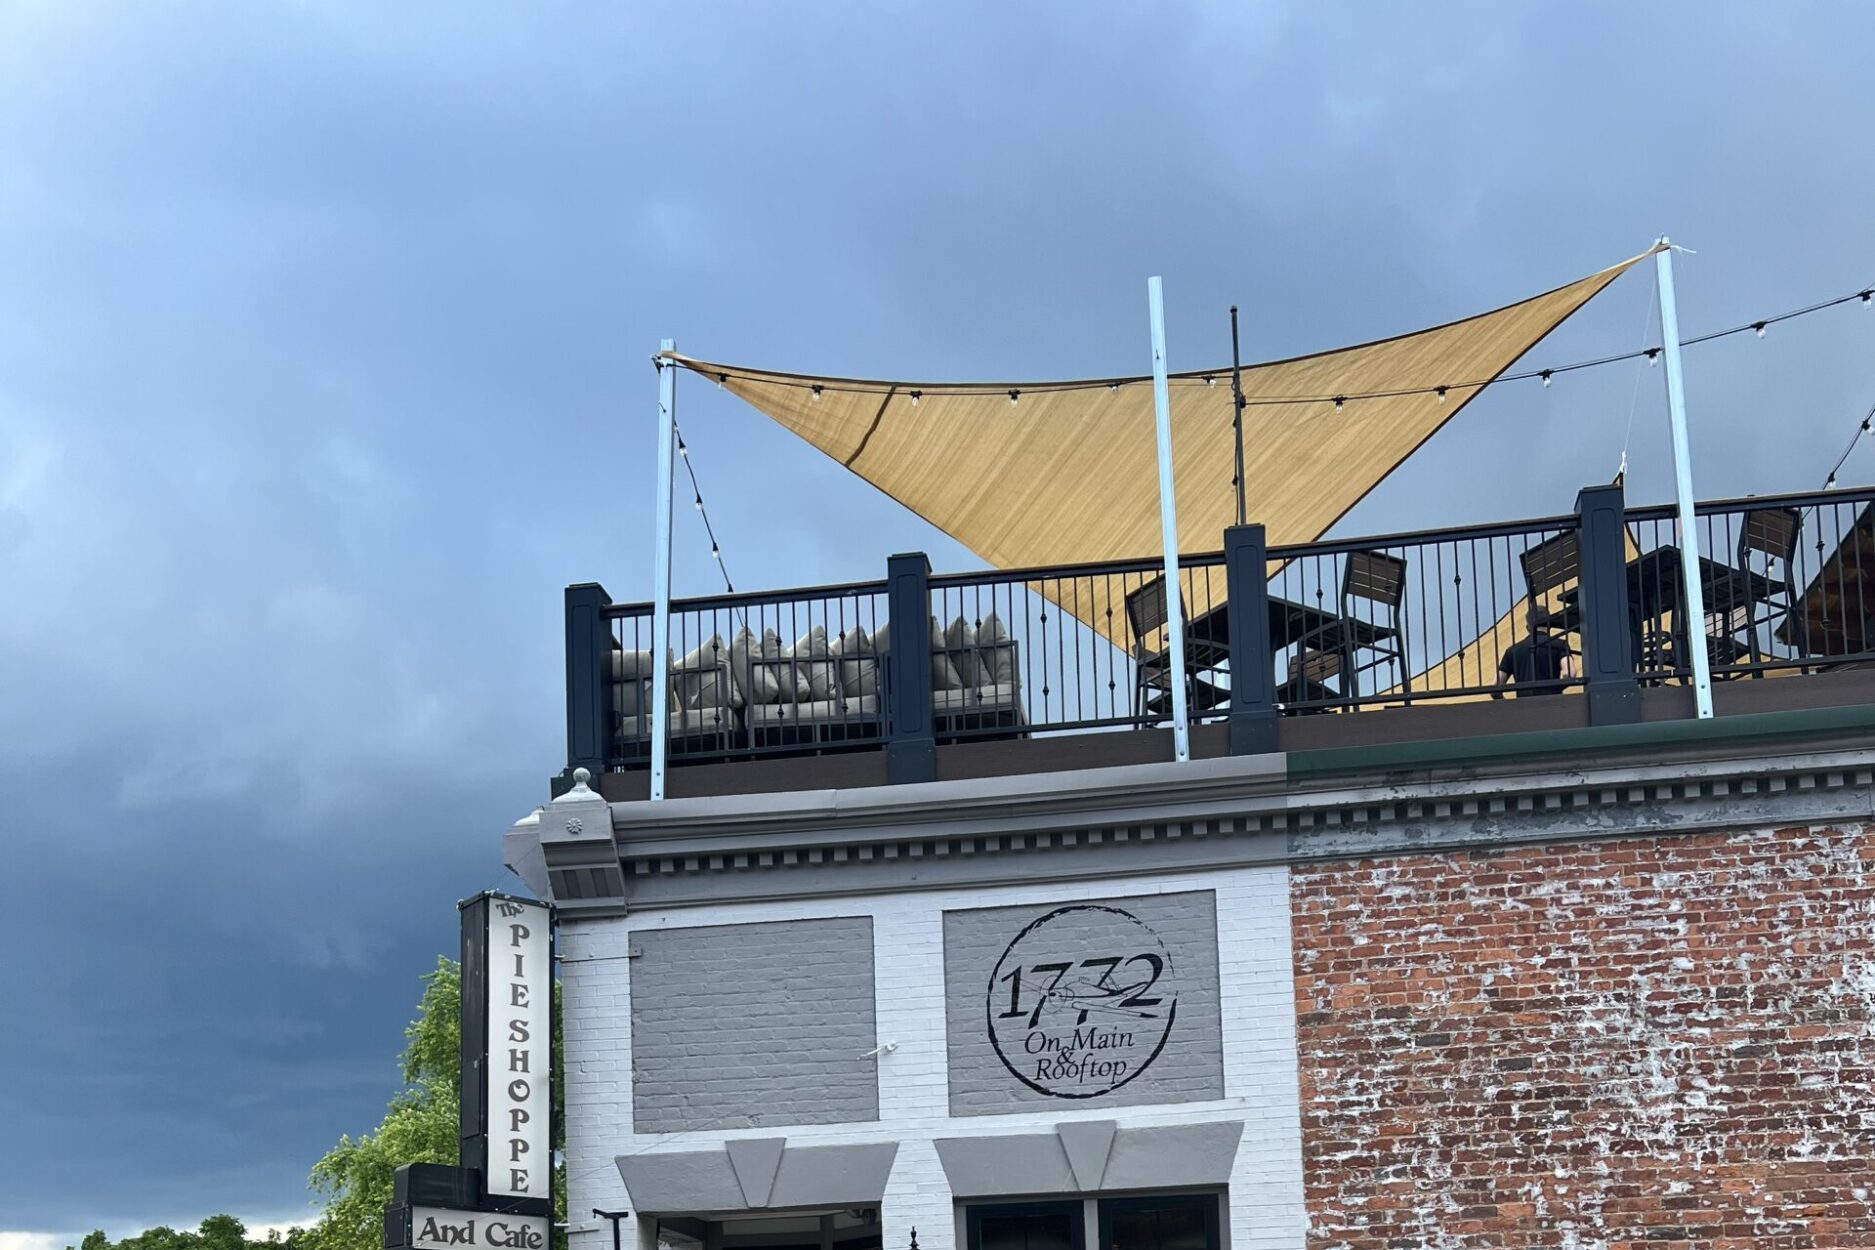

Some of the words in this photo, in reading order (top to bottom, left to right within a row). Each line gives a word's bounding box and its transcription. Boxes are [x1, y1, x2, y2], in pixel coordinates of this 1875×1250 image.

[496, 902, 525, 918] The
[1024, 1031, 1061, 1055] On
[1071, 1026, 1135, 1051] Main
[1034, 1053, 1127, 1084] Rooftop
[1056, 1045, 1076, 1066] &
[417, 1216, 476, 1246] And
[485, 1222, 543, 1249] Cafe
